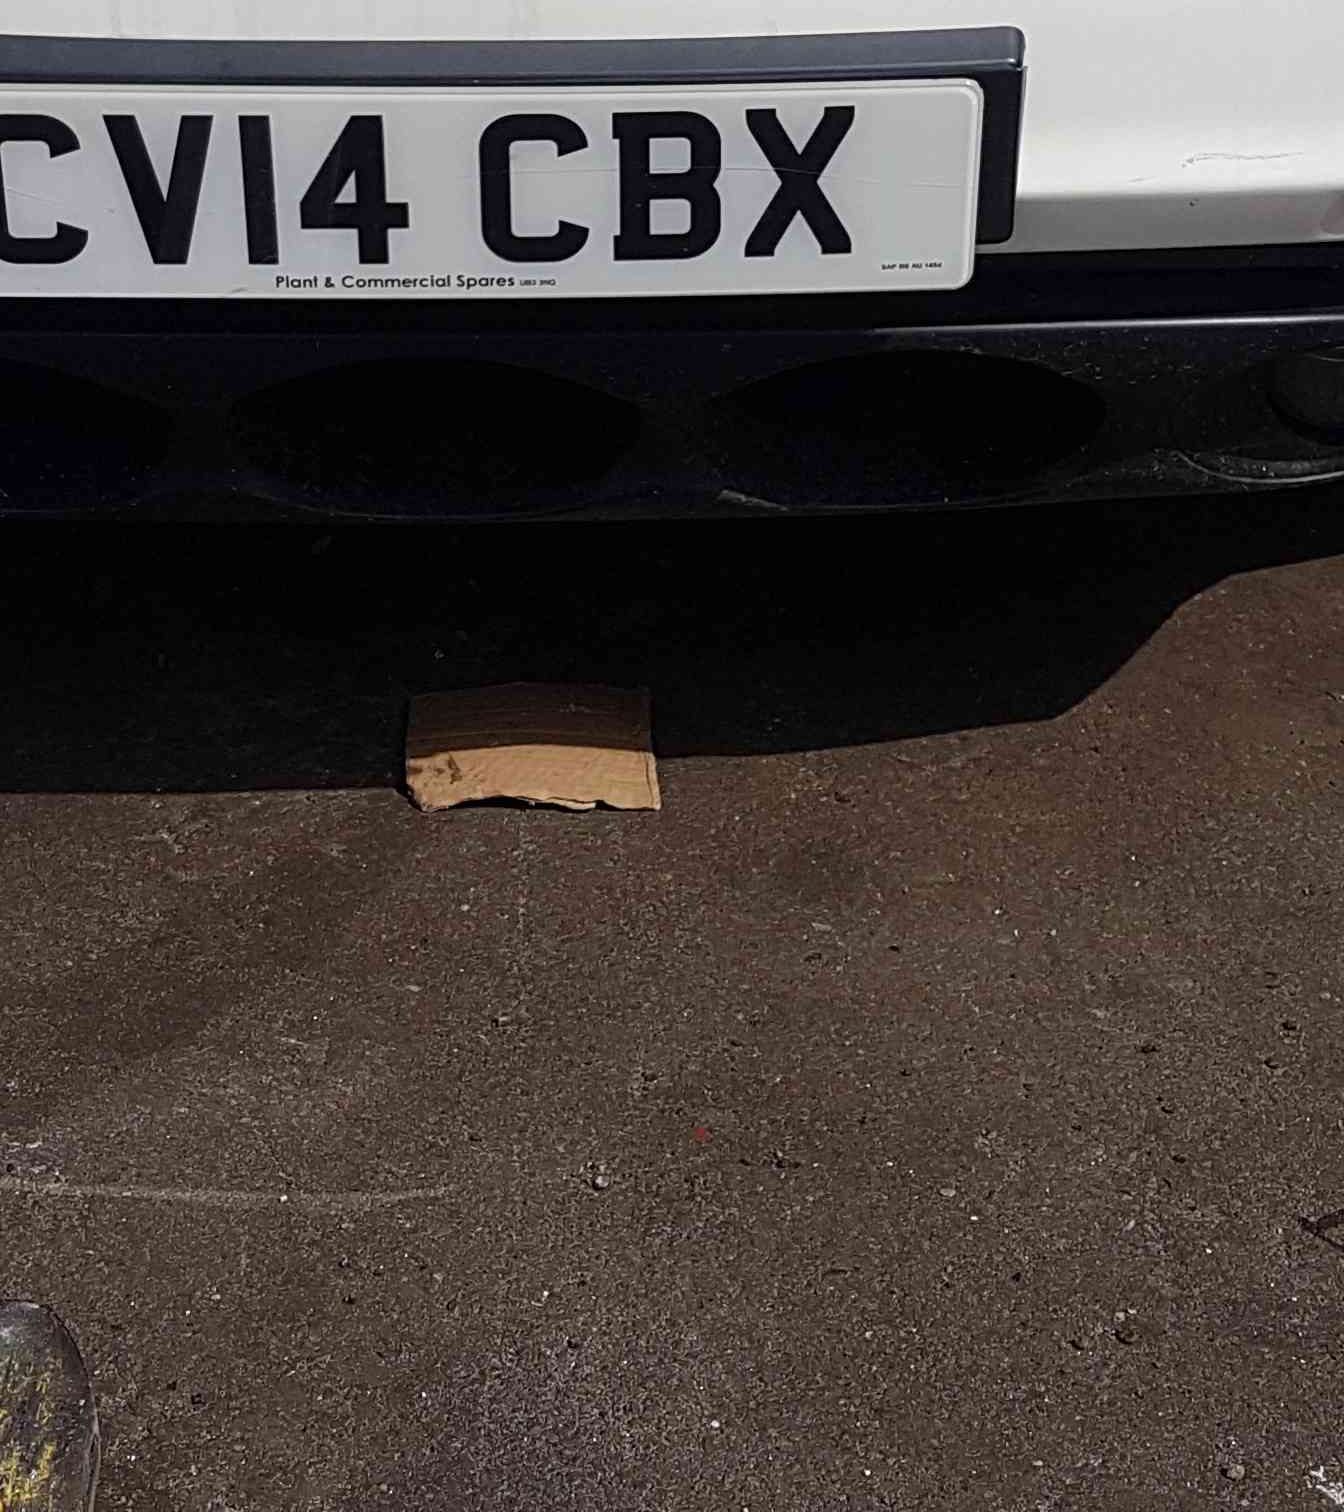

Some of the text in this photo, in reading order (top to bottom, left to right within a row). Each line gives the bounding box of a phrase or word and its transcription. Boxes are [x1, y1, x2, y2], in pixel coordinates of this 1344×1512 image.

[477, 105, 858, 262] CBX
[275, 275, 318, 289] Plant
[324, 276, 336, 289] &
[341, 274, 452, 289] Commercial
[456, 273, 516, 290] Spares
